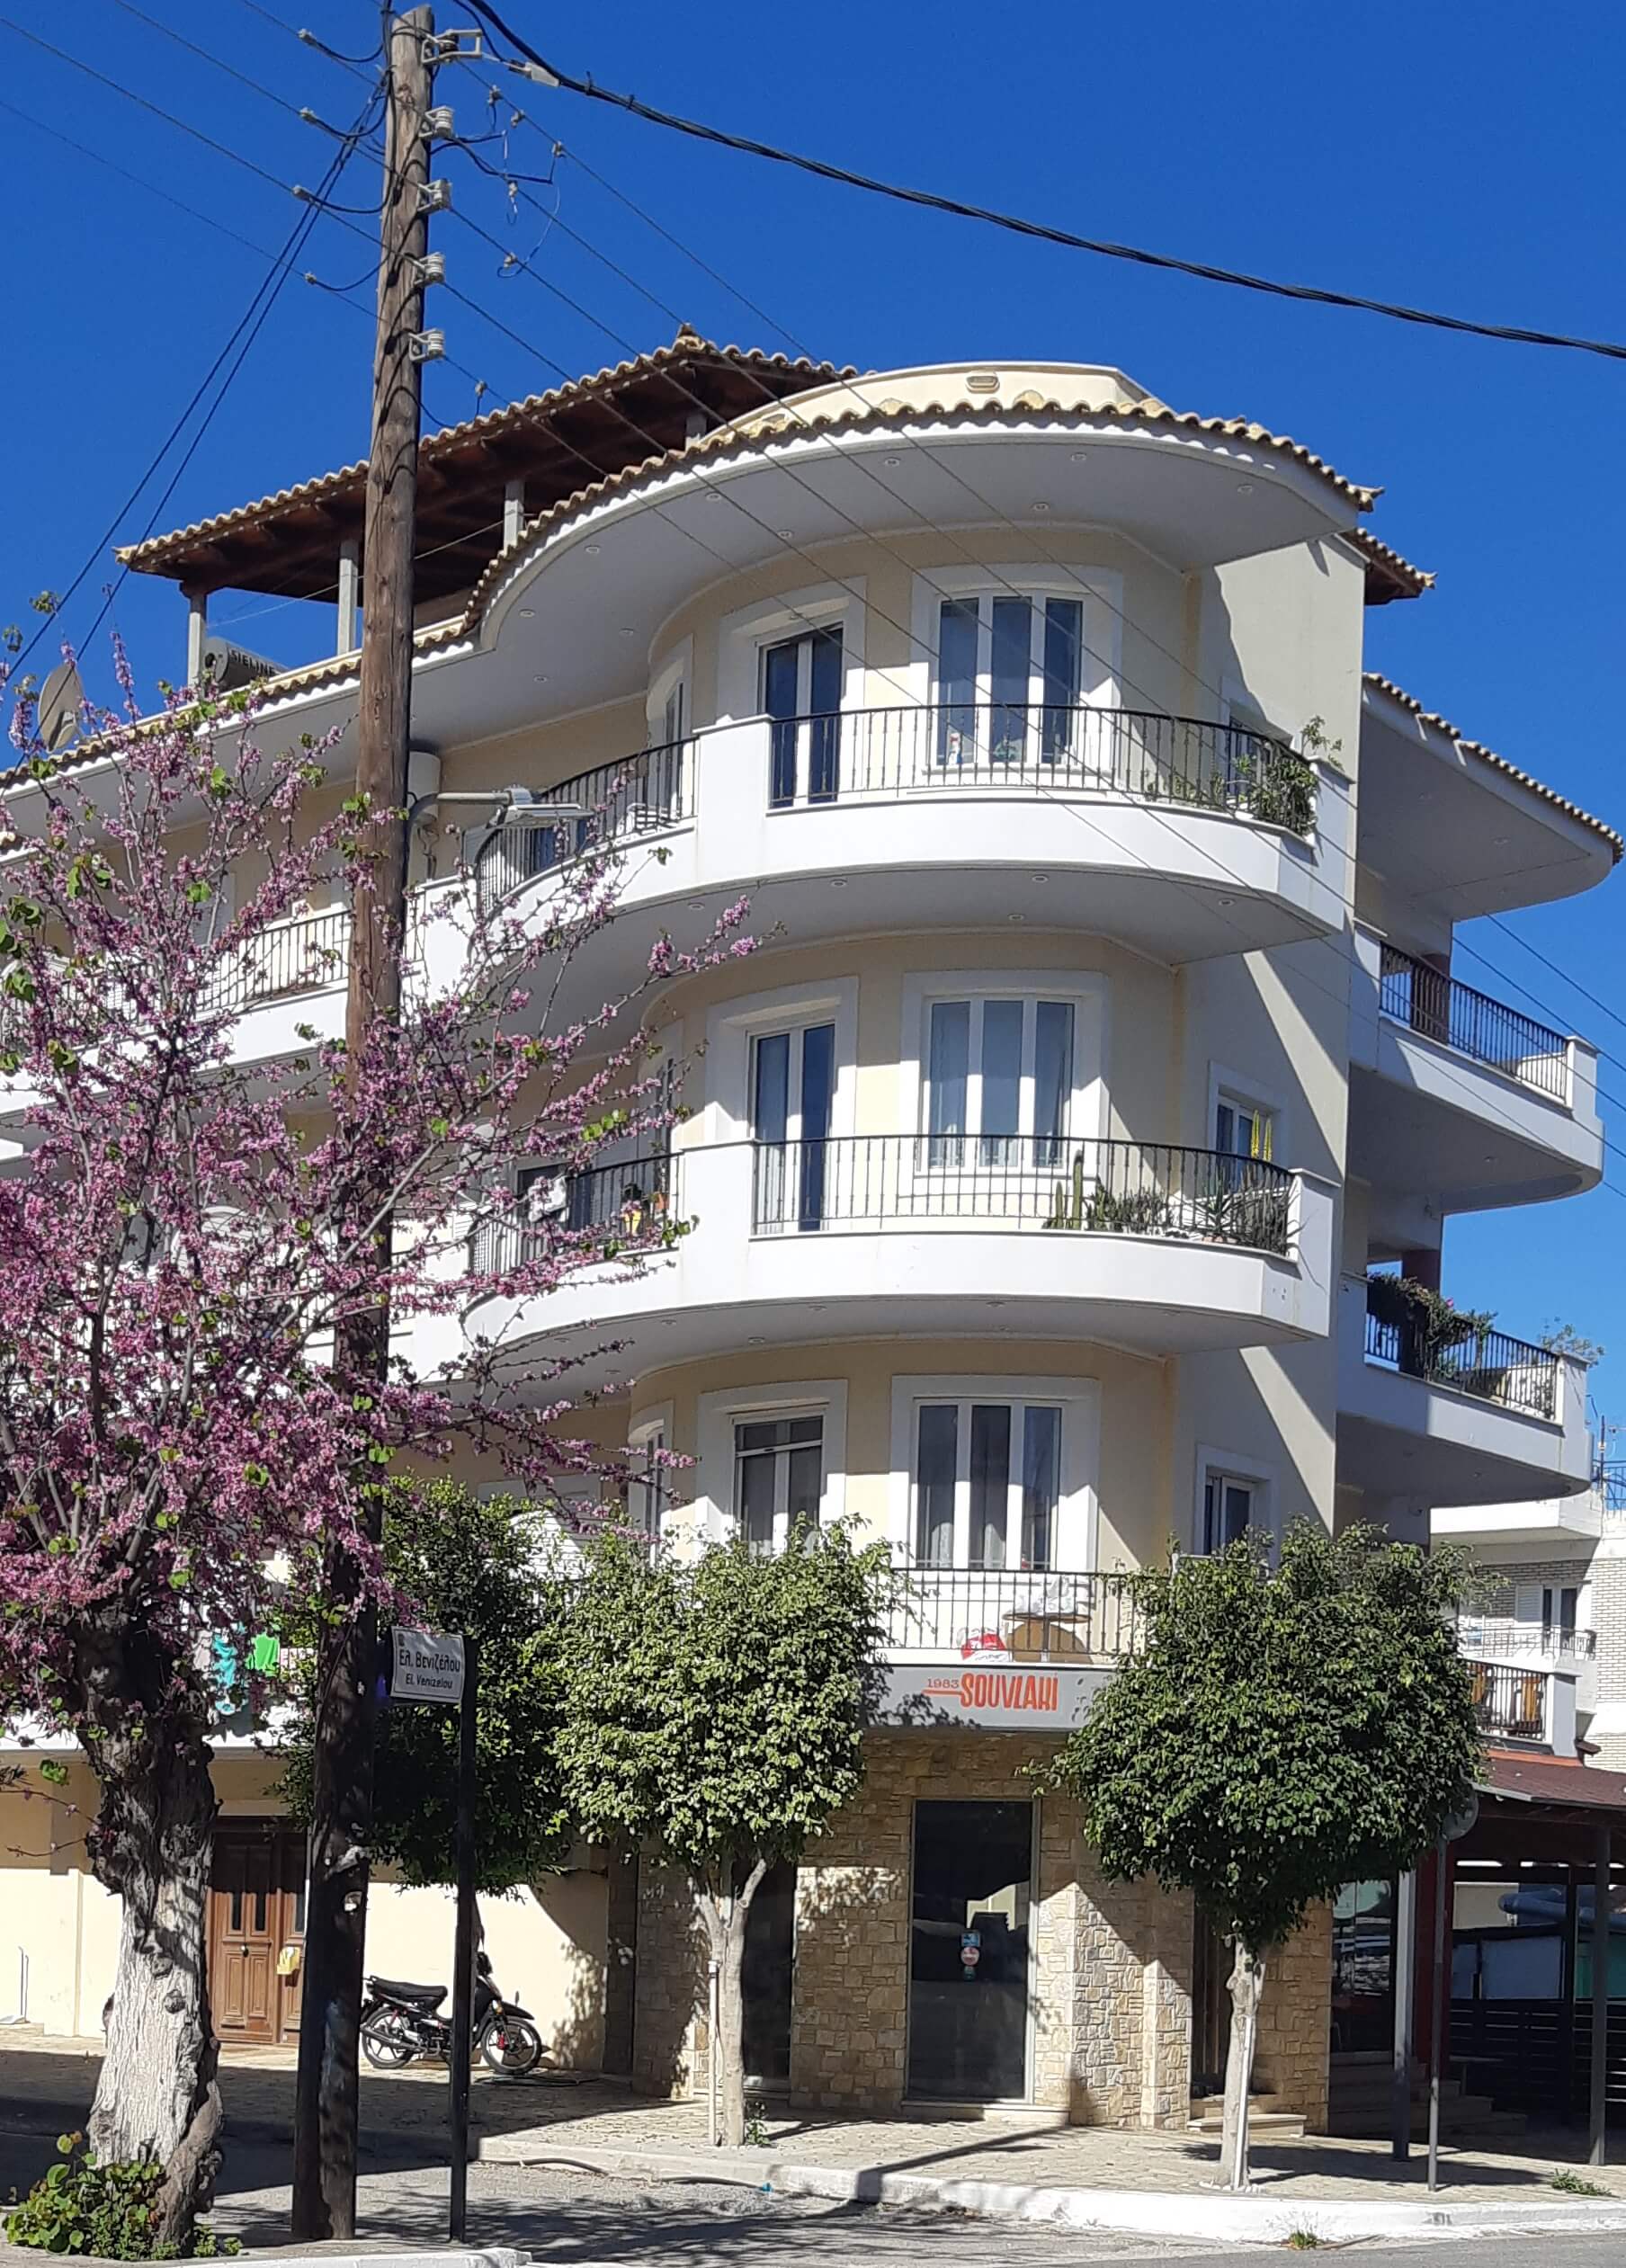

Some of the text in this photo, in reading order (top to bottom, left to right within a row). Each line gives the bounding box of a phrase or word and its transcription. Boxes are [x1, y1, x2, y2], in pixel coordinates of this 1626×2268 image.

[399, 1649, 460, 1674] Ελ. Βενιζέλου
[417, 1674, 453, 1689] Venizelou
[927, 1678, 959, 1689] 1983
